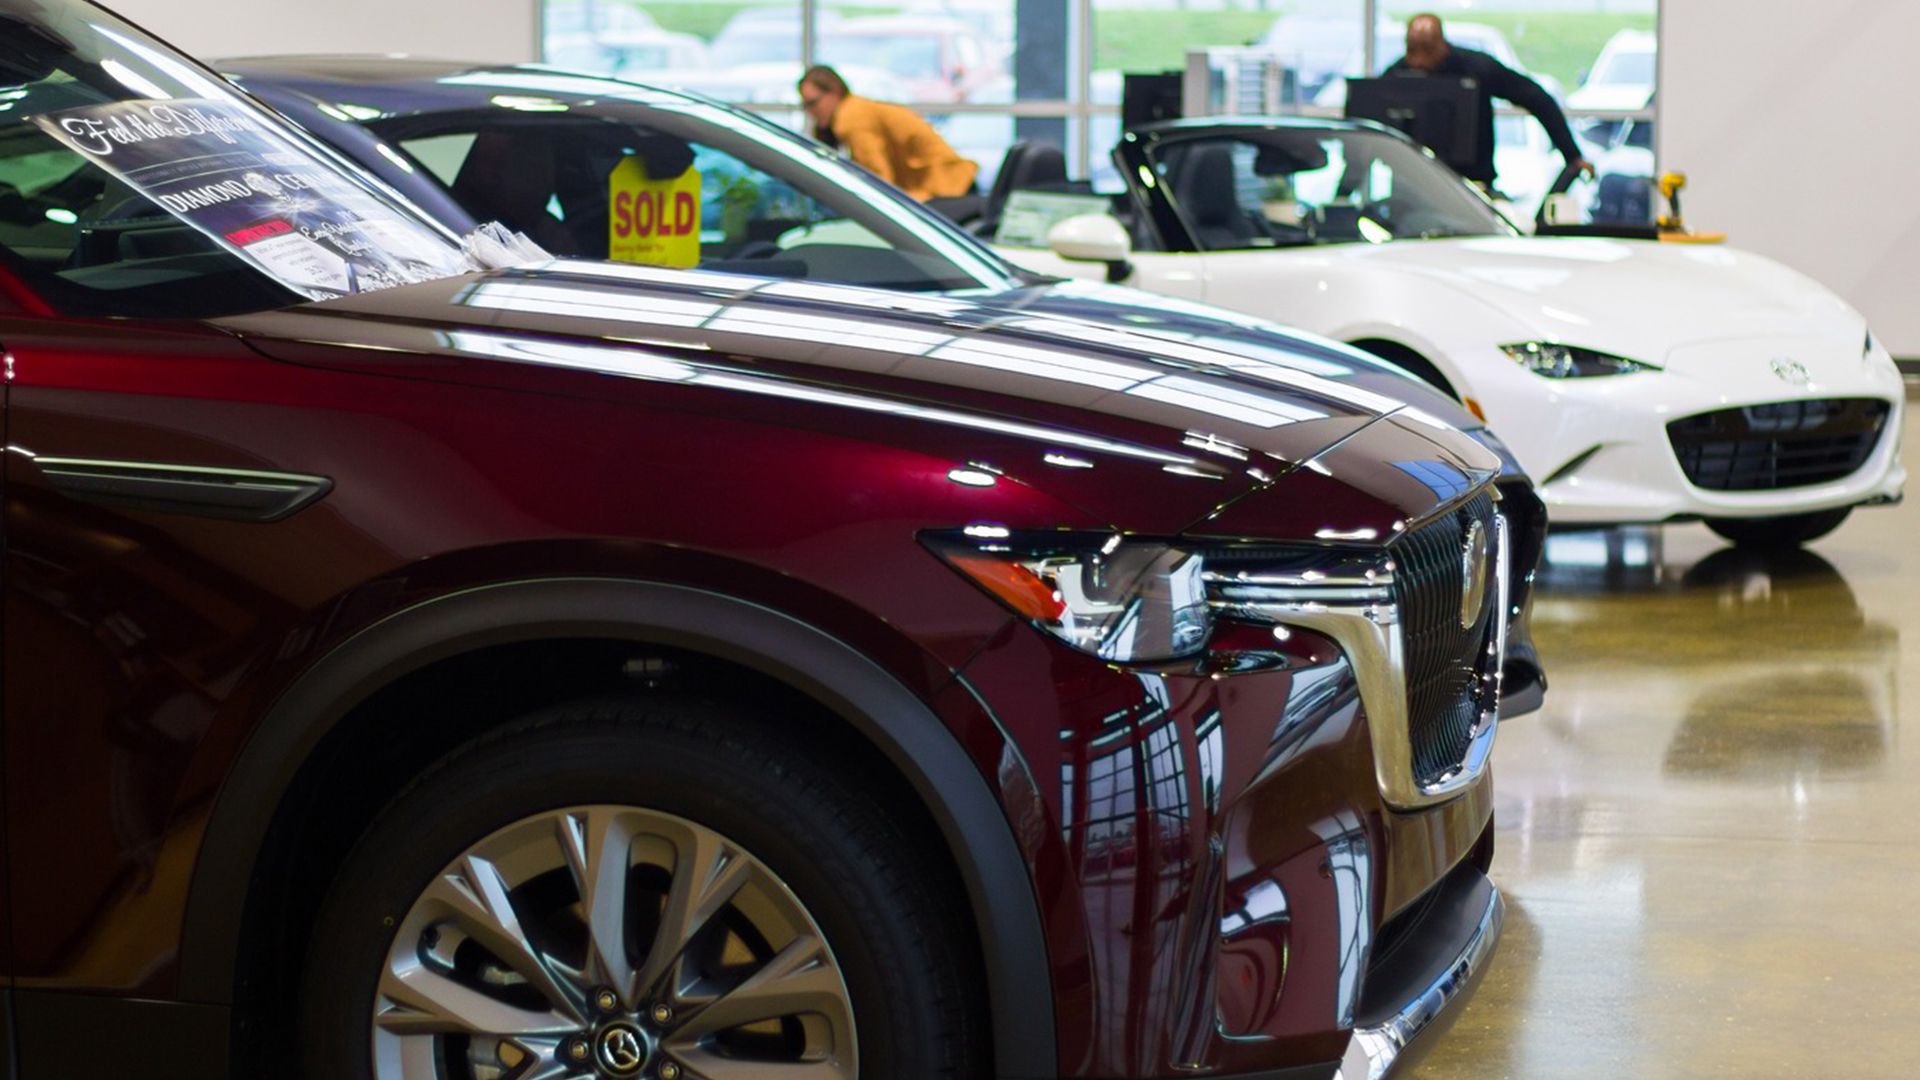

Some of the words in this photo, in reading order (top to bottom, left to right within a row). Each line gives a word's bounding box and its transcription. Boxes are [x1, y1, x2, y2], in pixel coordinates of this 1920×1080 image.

[61, 115, 142, 155] Feel
[125, 114, 173, 139] the
[158, 180, 252, 213] DIAMOND
[615, 191, 695, 238] SOLD
